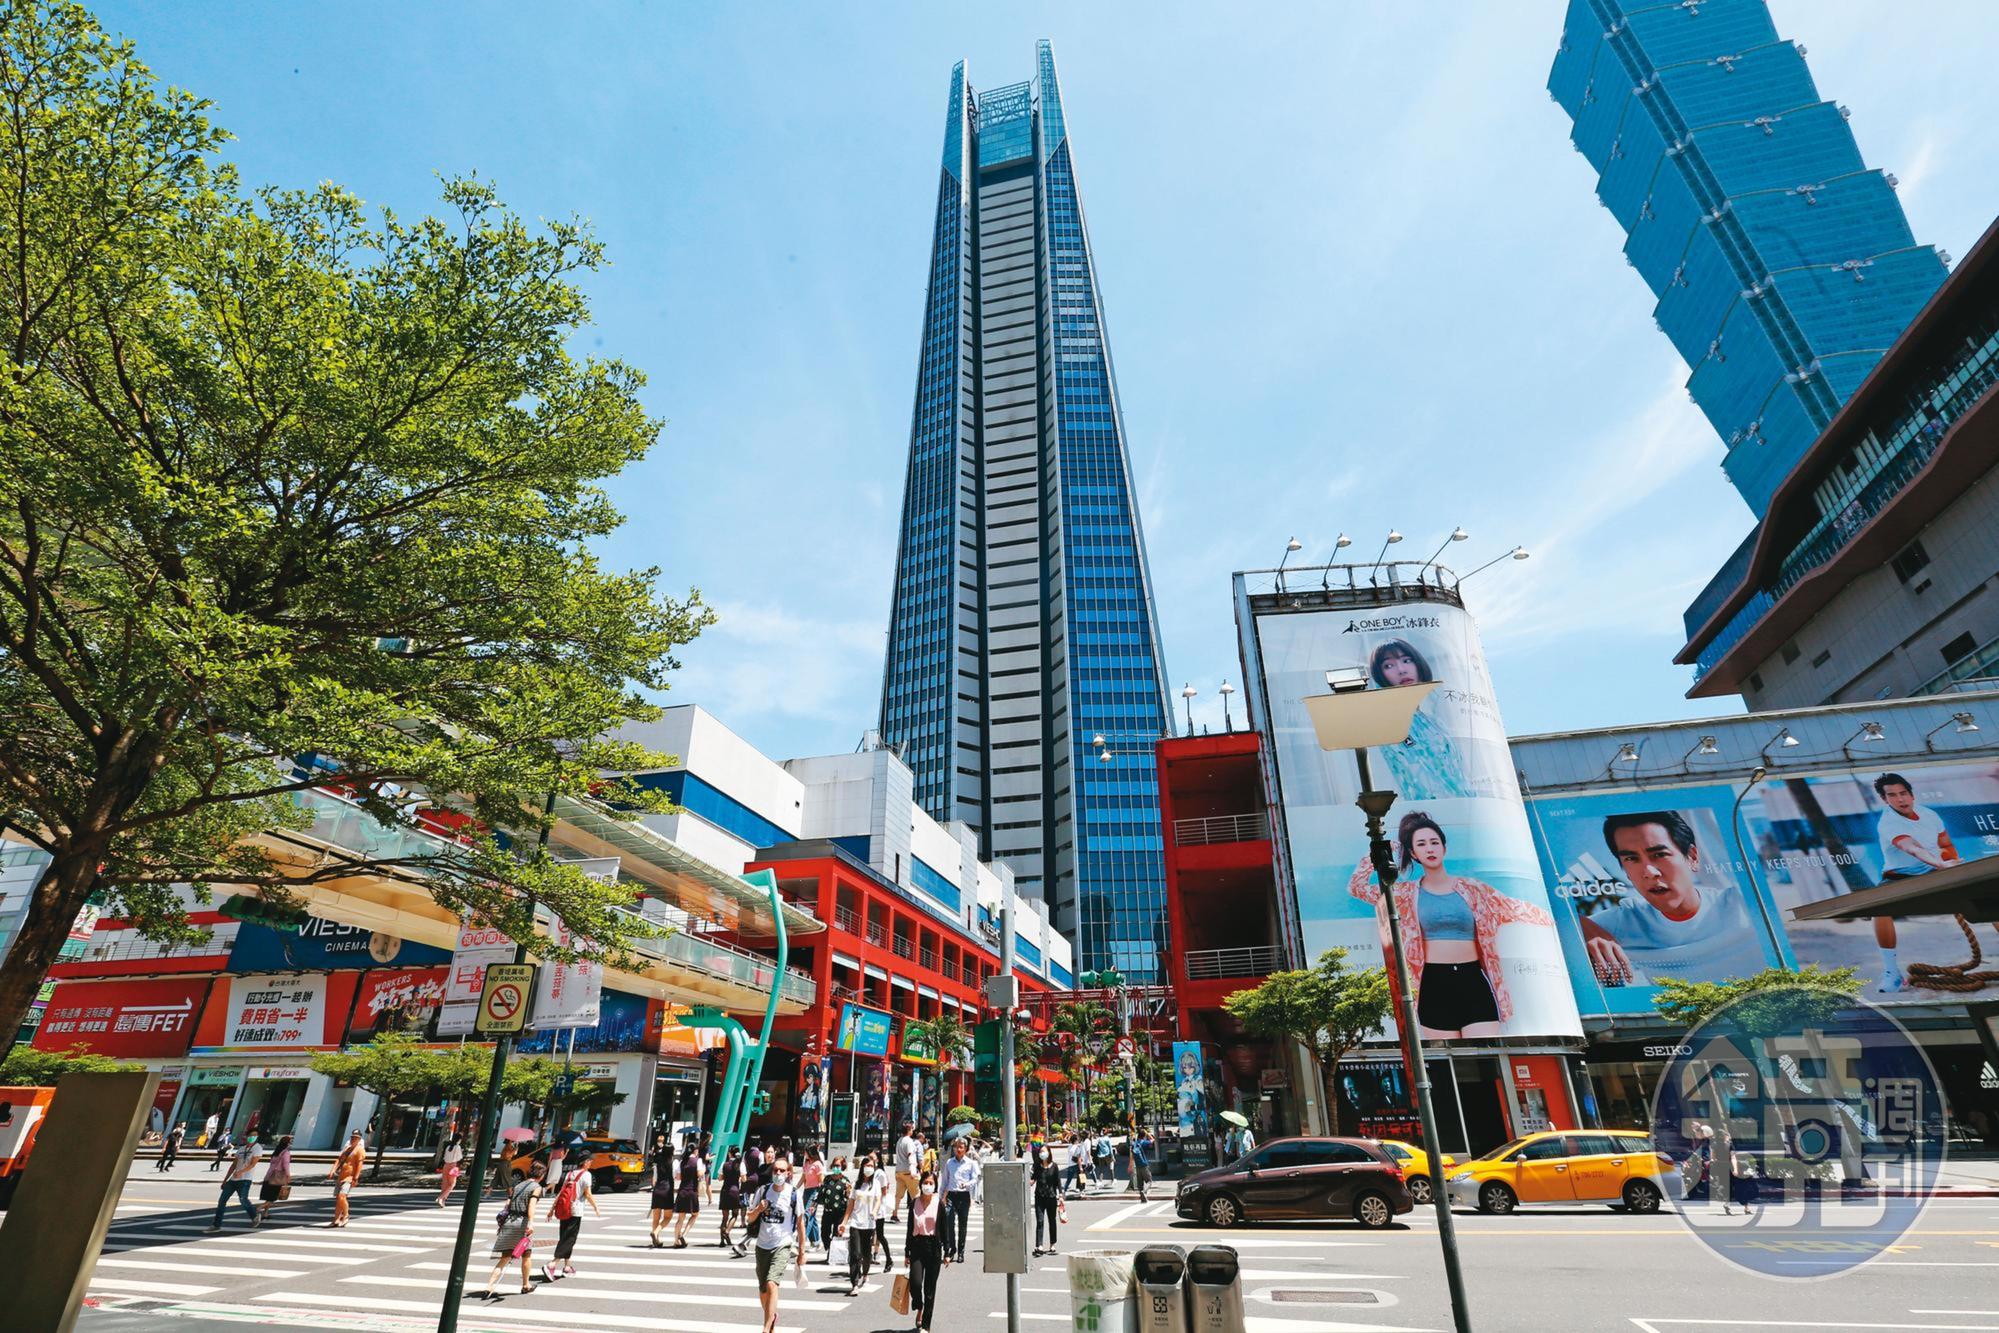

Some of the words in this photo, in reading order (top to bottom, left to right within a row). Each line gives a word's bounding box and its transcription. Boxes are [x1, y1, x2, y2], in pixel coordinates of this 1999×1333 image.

[1360, 618, 1382, 629] ONE
[1382, 616, 1402, 627] BOY
[1704, 861, 1758, 875] HEAT.RY
[1766, 858, 1800, 871] KEEPS
[1804, 855, 1826, 868] YOU
[1830, 853, 1859, 866] COOL
[1554, 879, 1629, 899] adidas
[374, 974, 413, 992] WORKERS
[238, 1006, 309, 1026] 費用省一半
[1643, 1044, 1693, 1057] SEIKO
